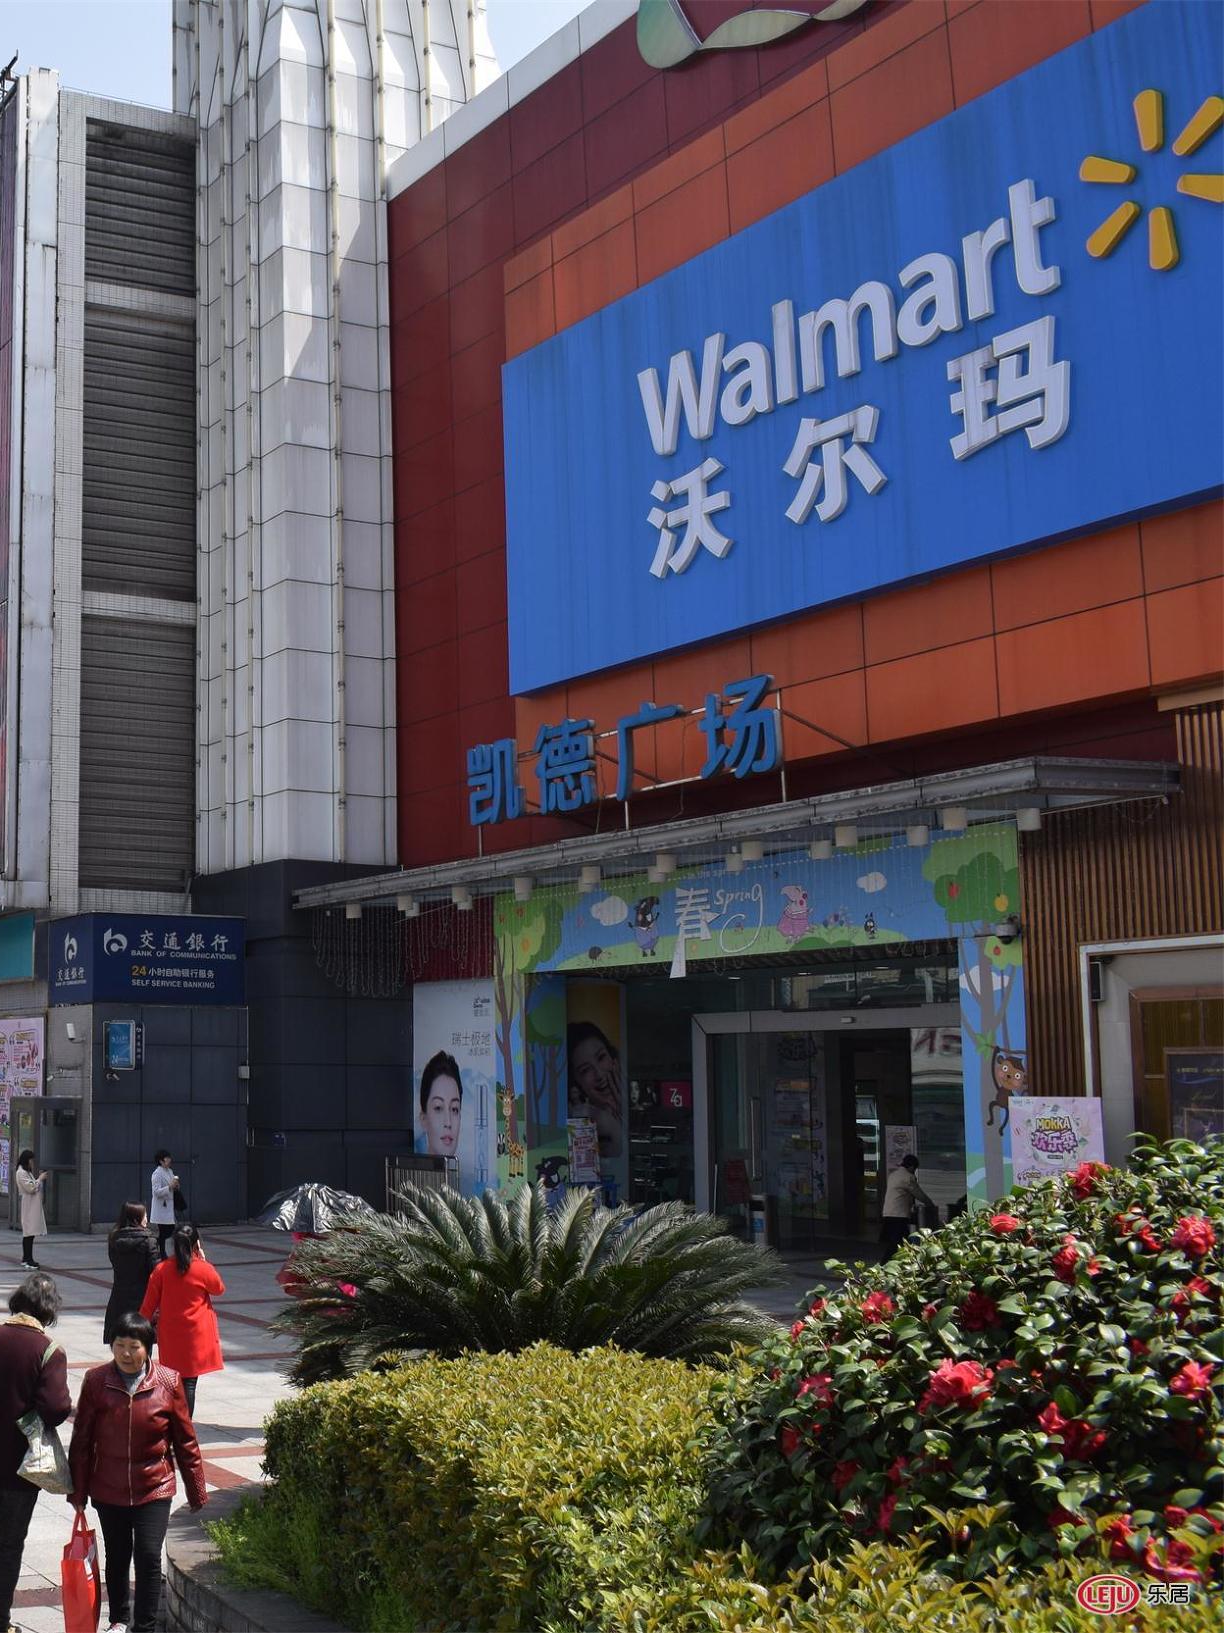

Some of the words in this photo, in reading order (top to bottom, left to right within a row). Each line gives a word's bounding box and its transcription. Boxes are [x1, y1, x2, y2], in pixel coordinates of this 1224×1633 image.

[637, 178, 1061, 456] Walmart
[647, 315, 1070, 579] 沃尔玛
[467, 674, 783, 826] 凯德广场
[170, 951, 237, 960] COMMUNICATIONS
[670, 886, 719, 979] 春
[131, 979, 150, 987] SELF
[151, 980, 182, 988] SERVICE
[183, 981, 216, 989] BANKING
[1036, 1115, 1072, 1131] MOKKA
